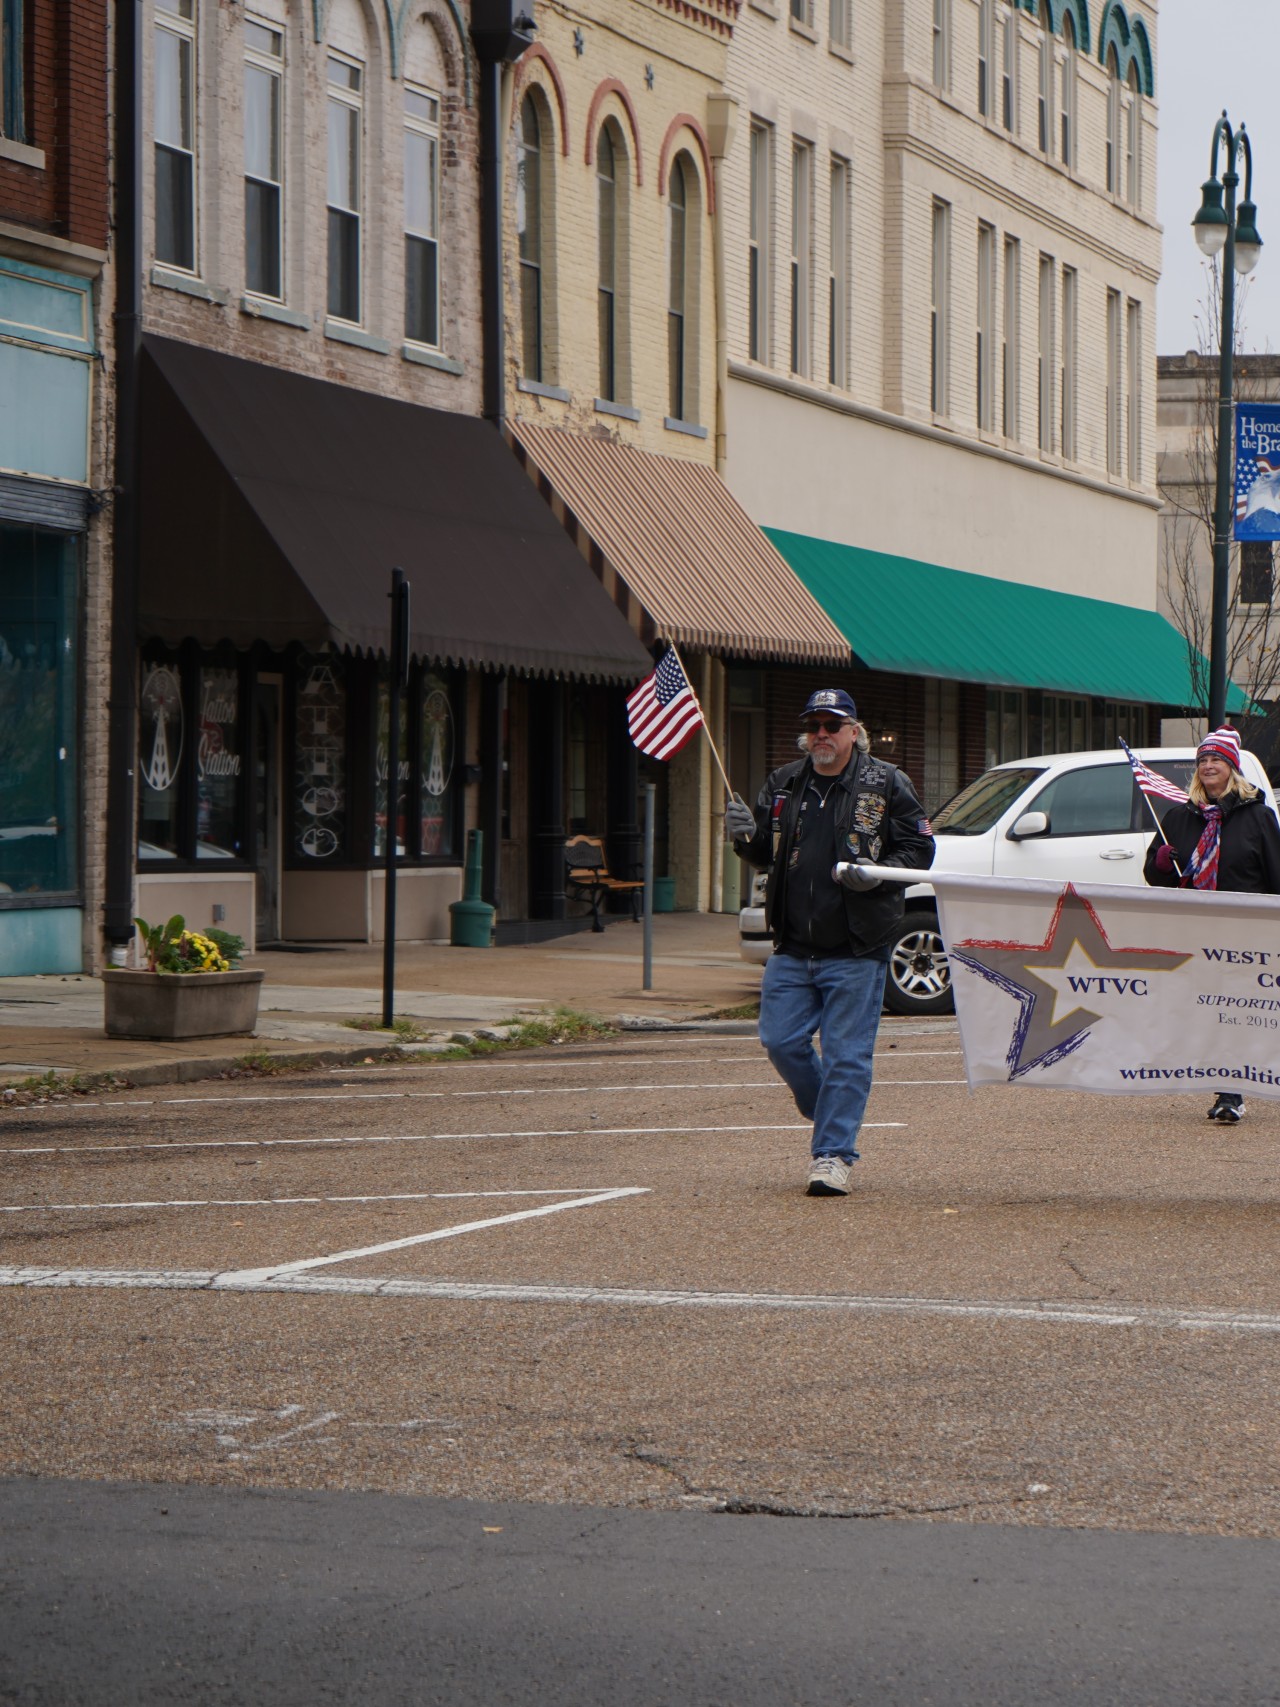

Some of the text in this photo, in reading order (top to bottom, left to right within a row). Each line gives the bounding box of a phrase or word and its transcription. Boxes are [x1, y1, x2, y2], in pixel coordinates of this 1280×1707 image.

[1242, 435, 1257, 449] the
[200, 682, 235, 729] Tattoo
[198, 733, 240, 781] Station
[1201, 948, 1270, 965] WEST
[1066, 976, 1149, 996] WTVC
[1218, 1012, 1279, 1030] Est. 2019
